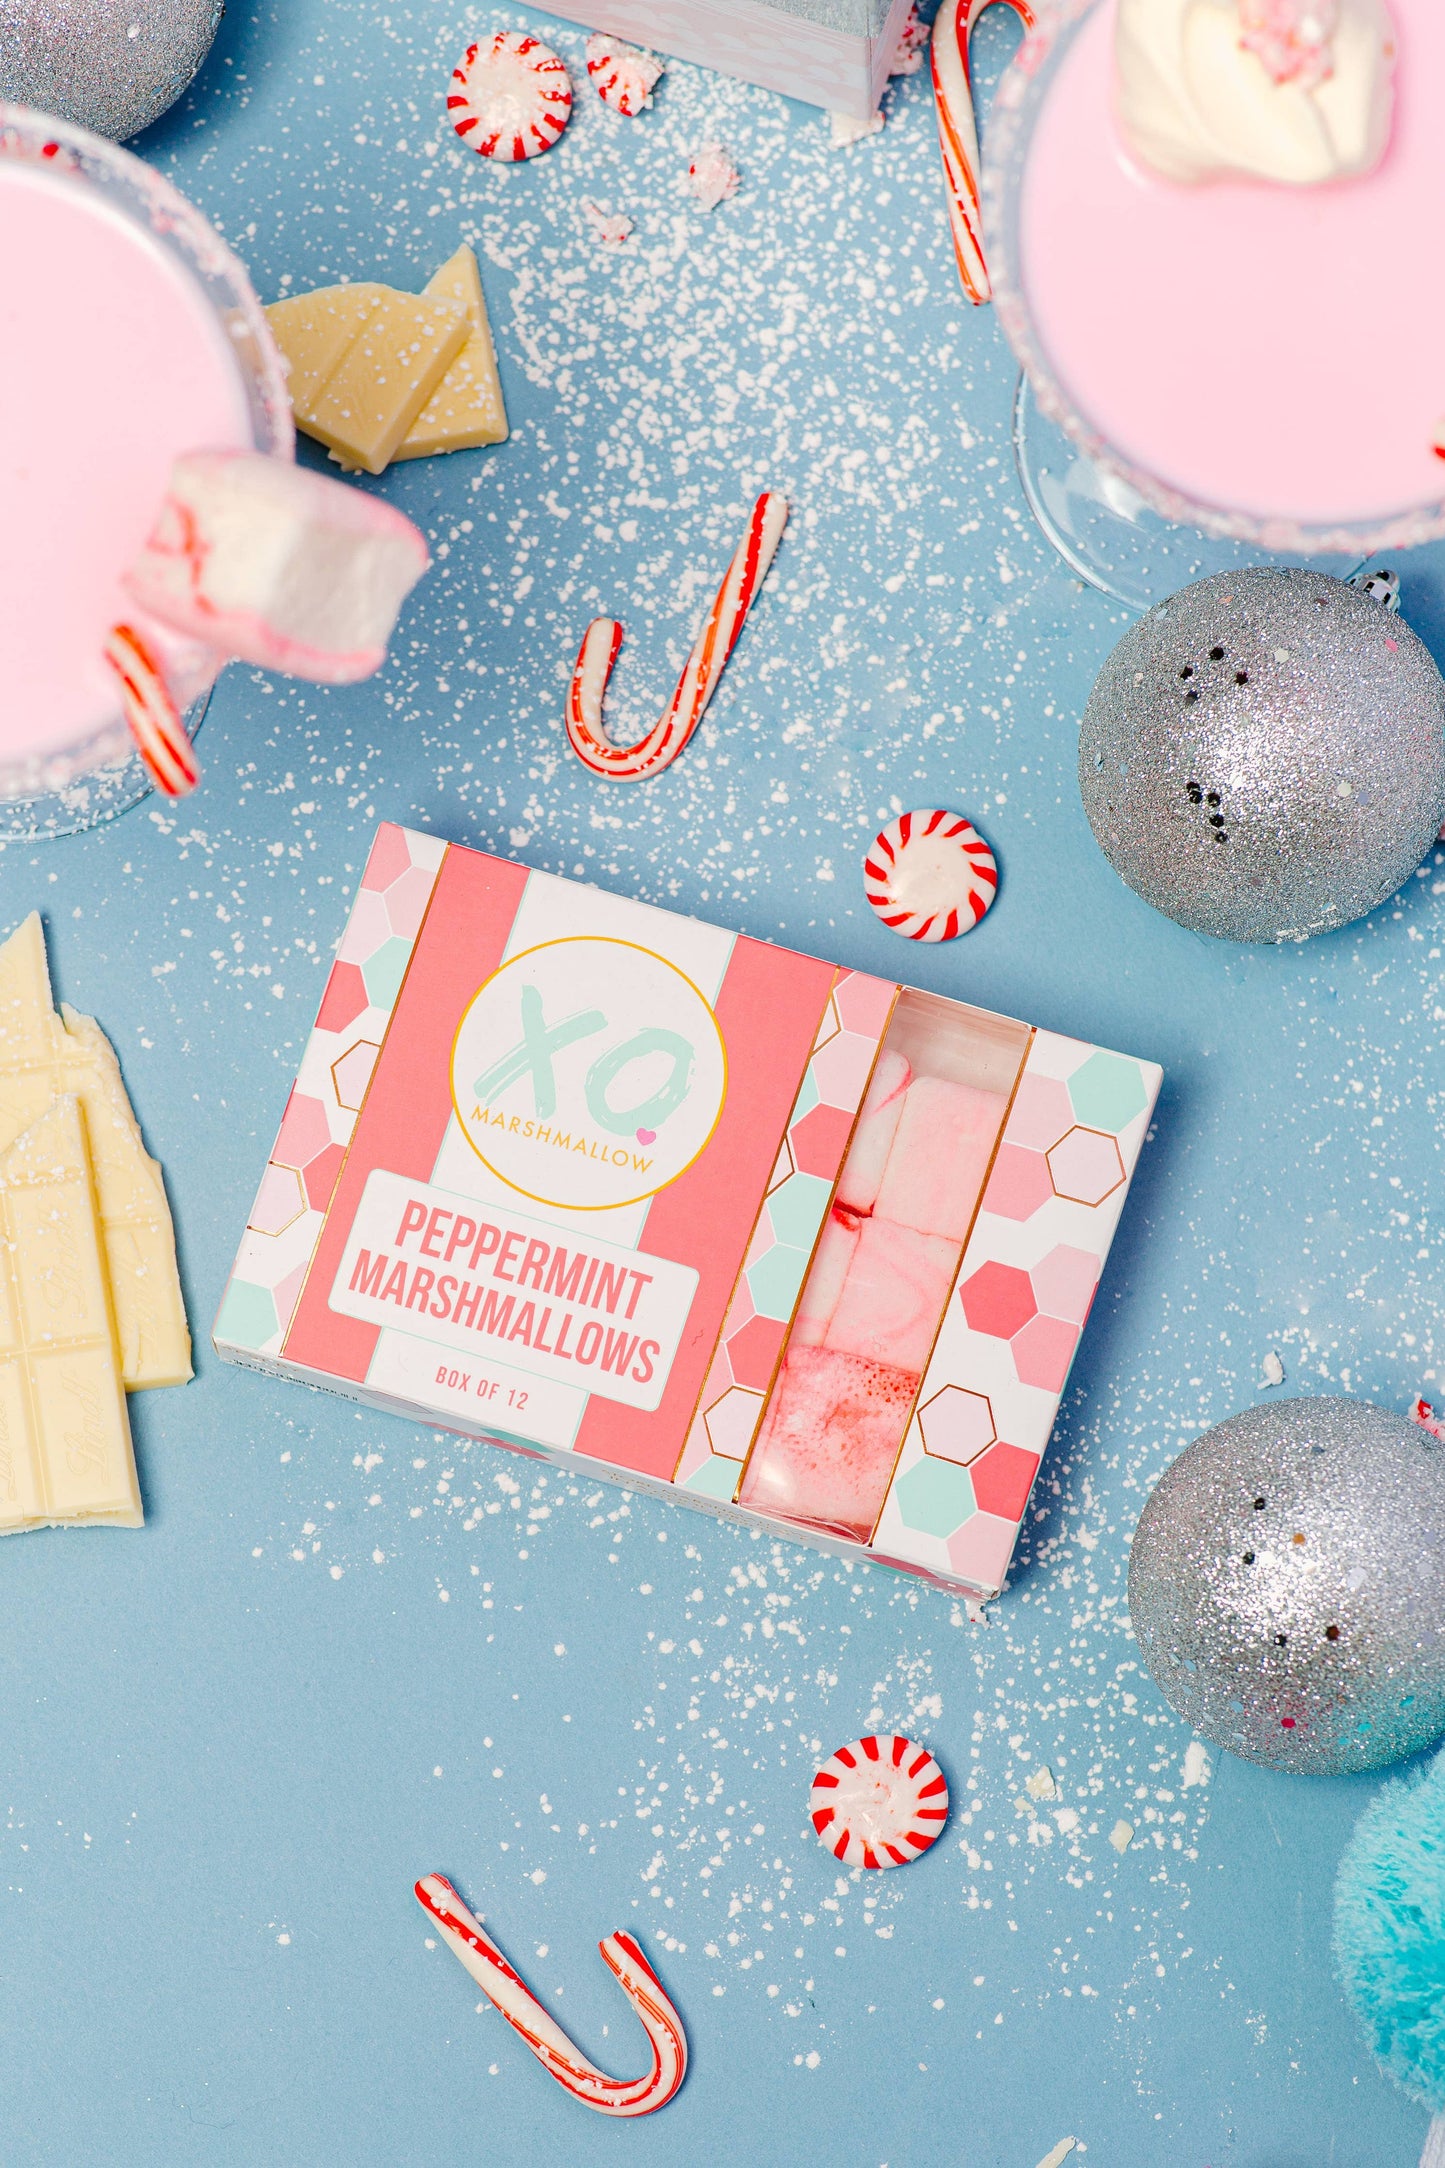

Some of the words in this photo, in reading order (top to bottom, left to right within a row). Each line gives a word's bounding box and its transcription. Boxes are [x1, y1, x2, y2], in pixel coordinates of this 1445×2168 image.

[473, 984, 697, 1137] XO
[470, 1104, 654, 1174] MARSHMALLOW
[348, 1248, 661, 1384] MARSHMALLOWS
[394, 1199, 653, 1320] PEPPERMINT
[435, 1366, 471, 1392] BOX
[476, 1379, 500, 1400] OF
[508, 1389, 529, 1410] 12
